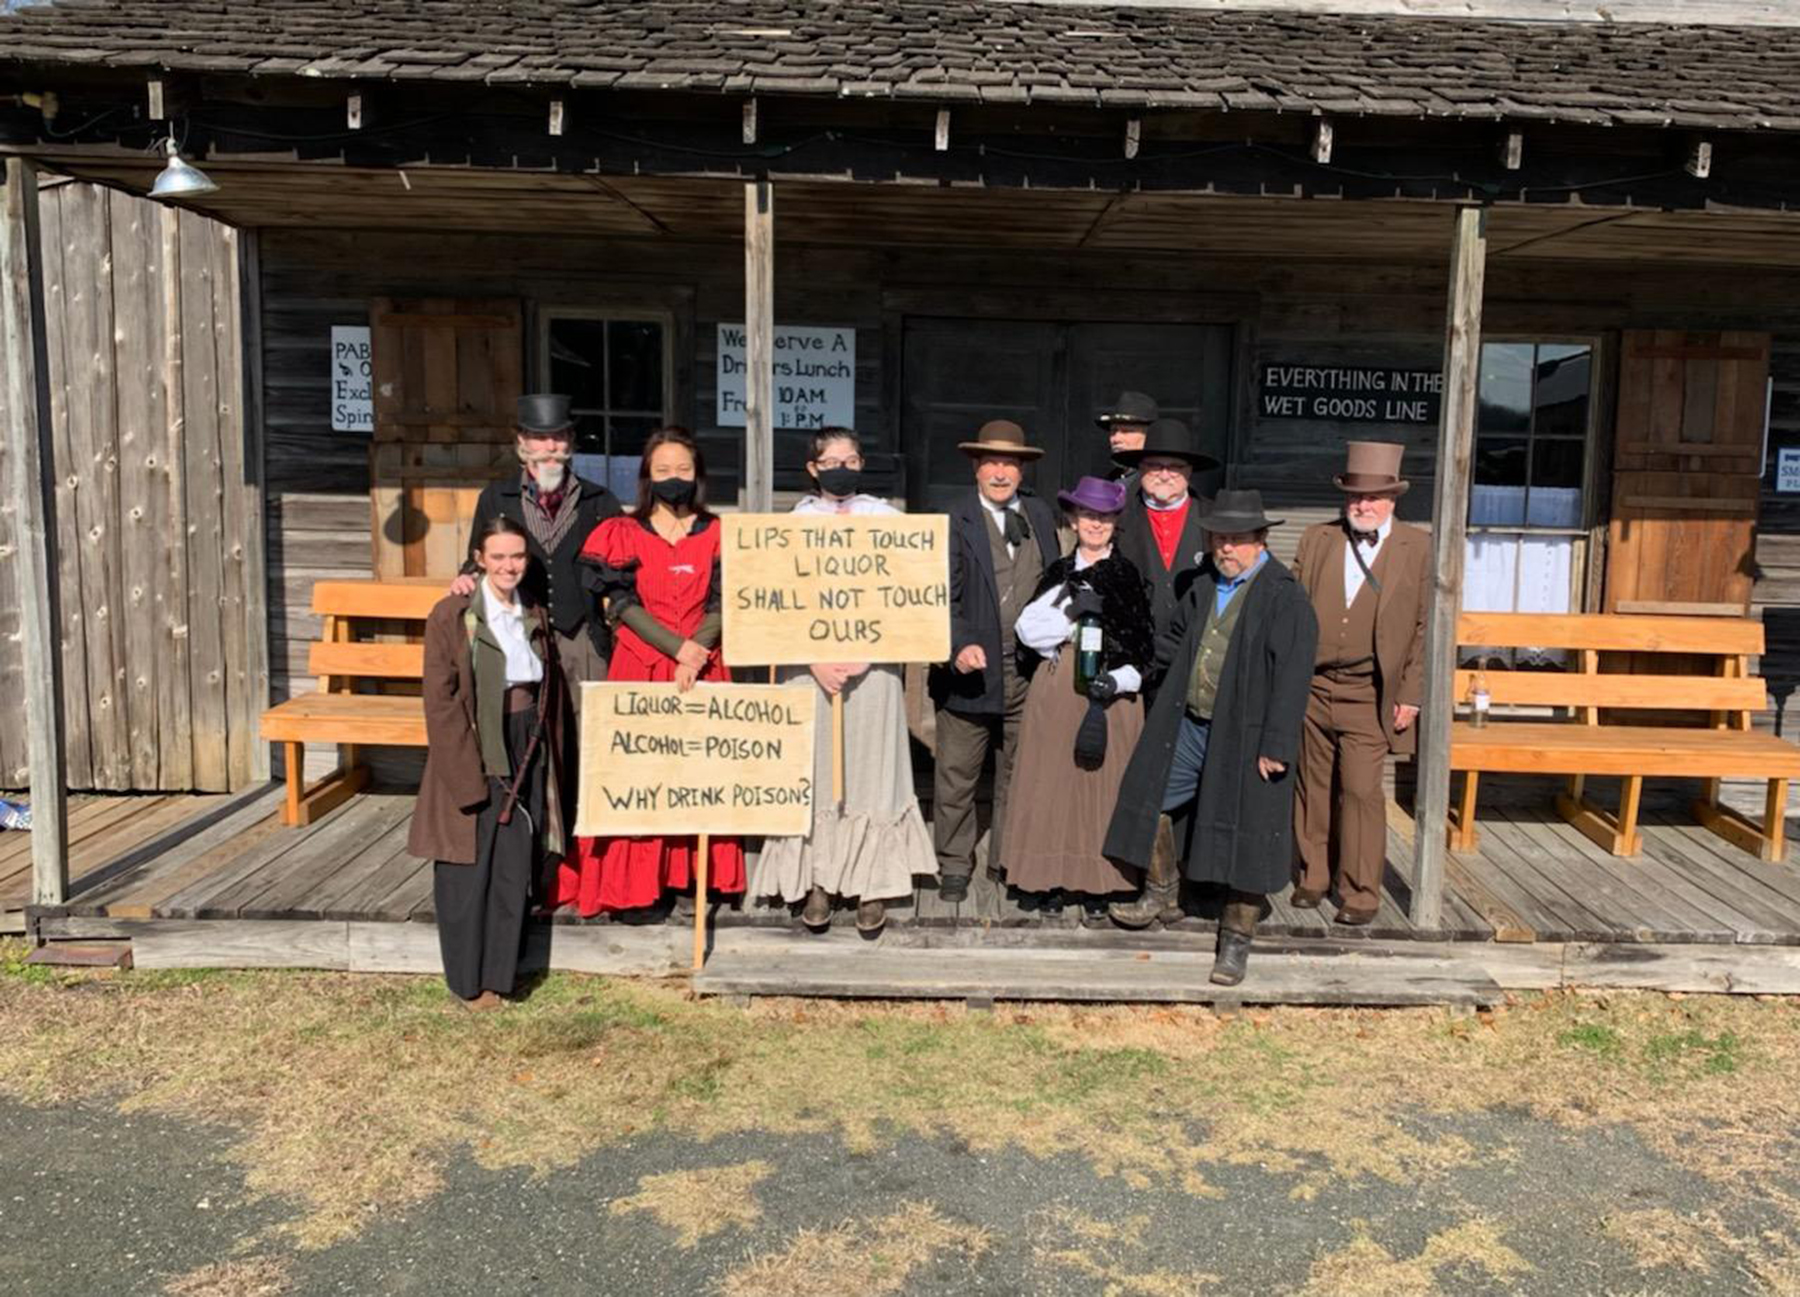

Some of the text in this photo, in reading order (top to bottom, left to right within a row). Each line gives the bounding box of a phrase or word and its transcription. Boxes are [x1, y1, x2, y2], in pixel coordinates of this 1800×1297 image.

[721, 329, 847, 351] We erve A
[722, 354, 850, 377] Drrs Lunch
[1265, 367, 1444, 394] EVERYTHING IN THE
[722, 390, 755, 412] Fr
[1264, 396, 1428, 421] WET GOODS LINE
[738, 527, 934, 550] LIPS THAT TOUCH
[794, 554, 891, 577] LIQUOR
[737, 583, 947, 612] SHALL NOT TOUCH
[809, 618, 882, 643] OURS
[602, 777, 812, 810] WHY DRINK POISON?
